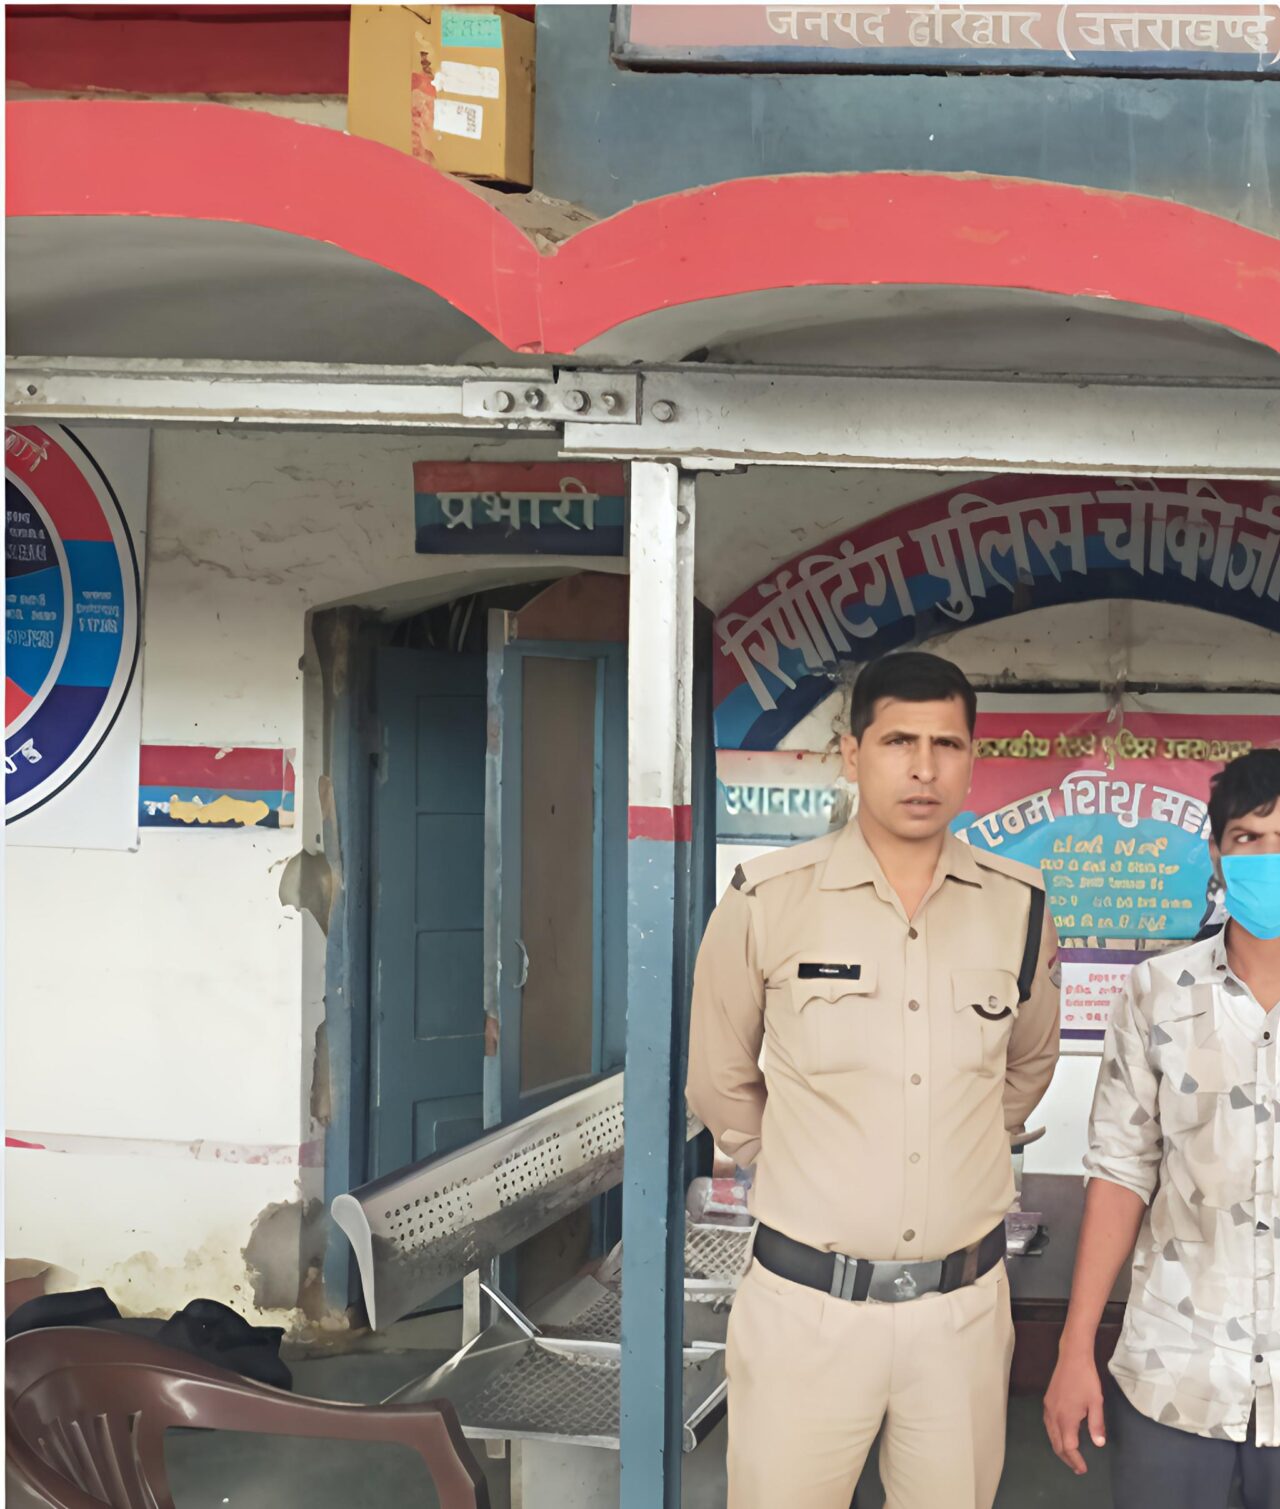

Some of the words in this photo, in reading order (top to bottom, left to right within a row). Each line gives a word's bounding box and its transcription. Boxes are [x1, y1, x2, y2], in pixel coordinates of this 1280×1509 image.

[766, 7, 890, 44] जनपद
[436, 476, 600, 531] प्रभारी
[909, 493, 1098, 622] पुलिस
